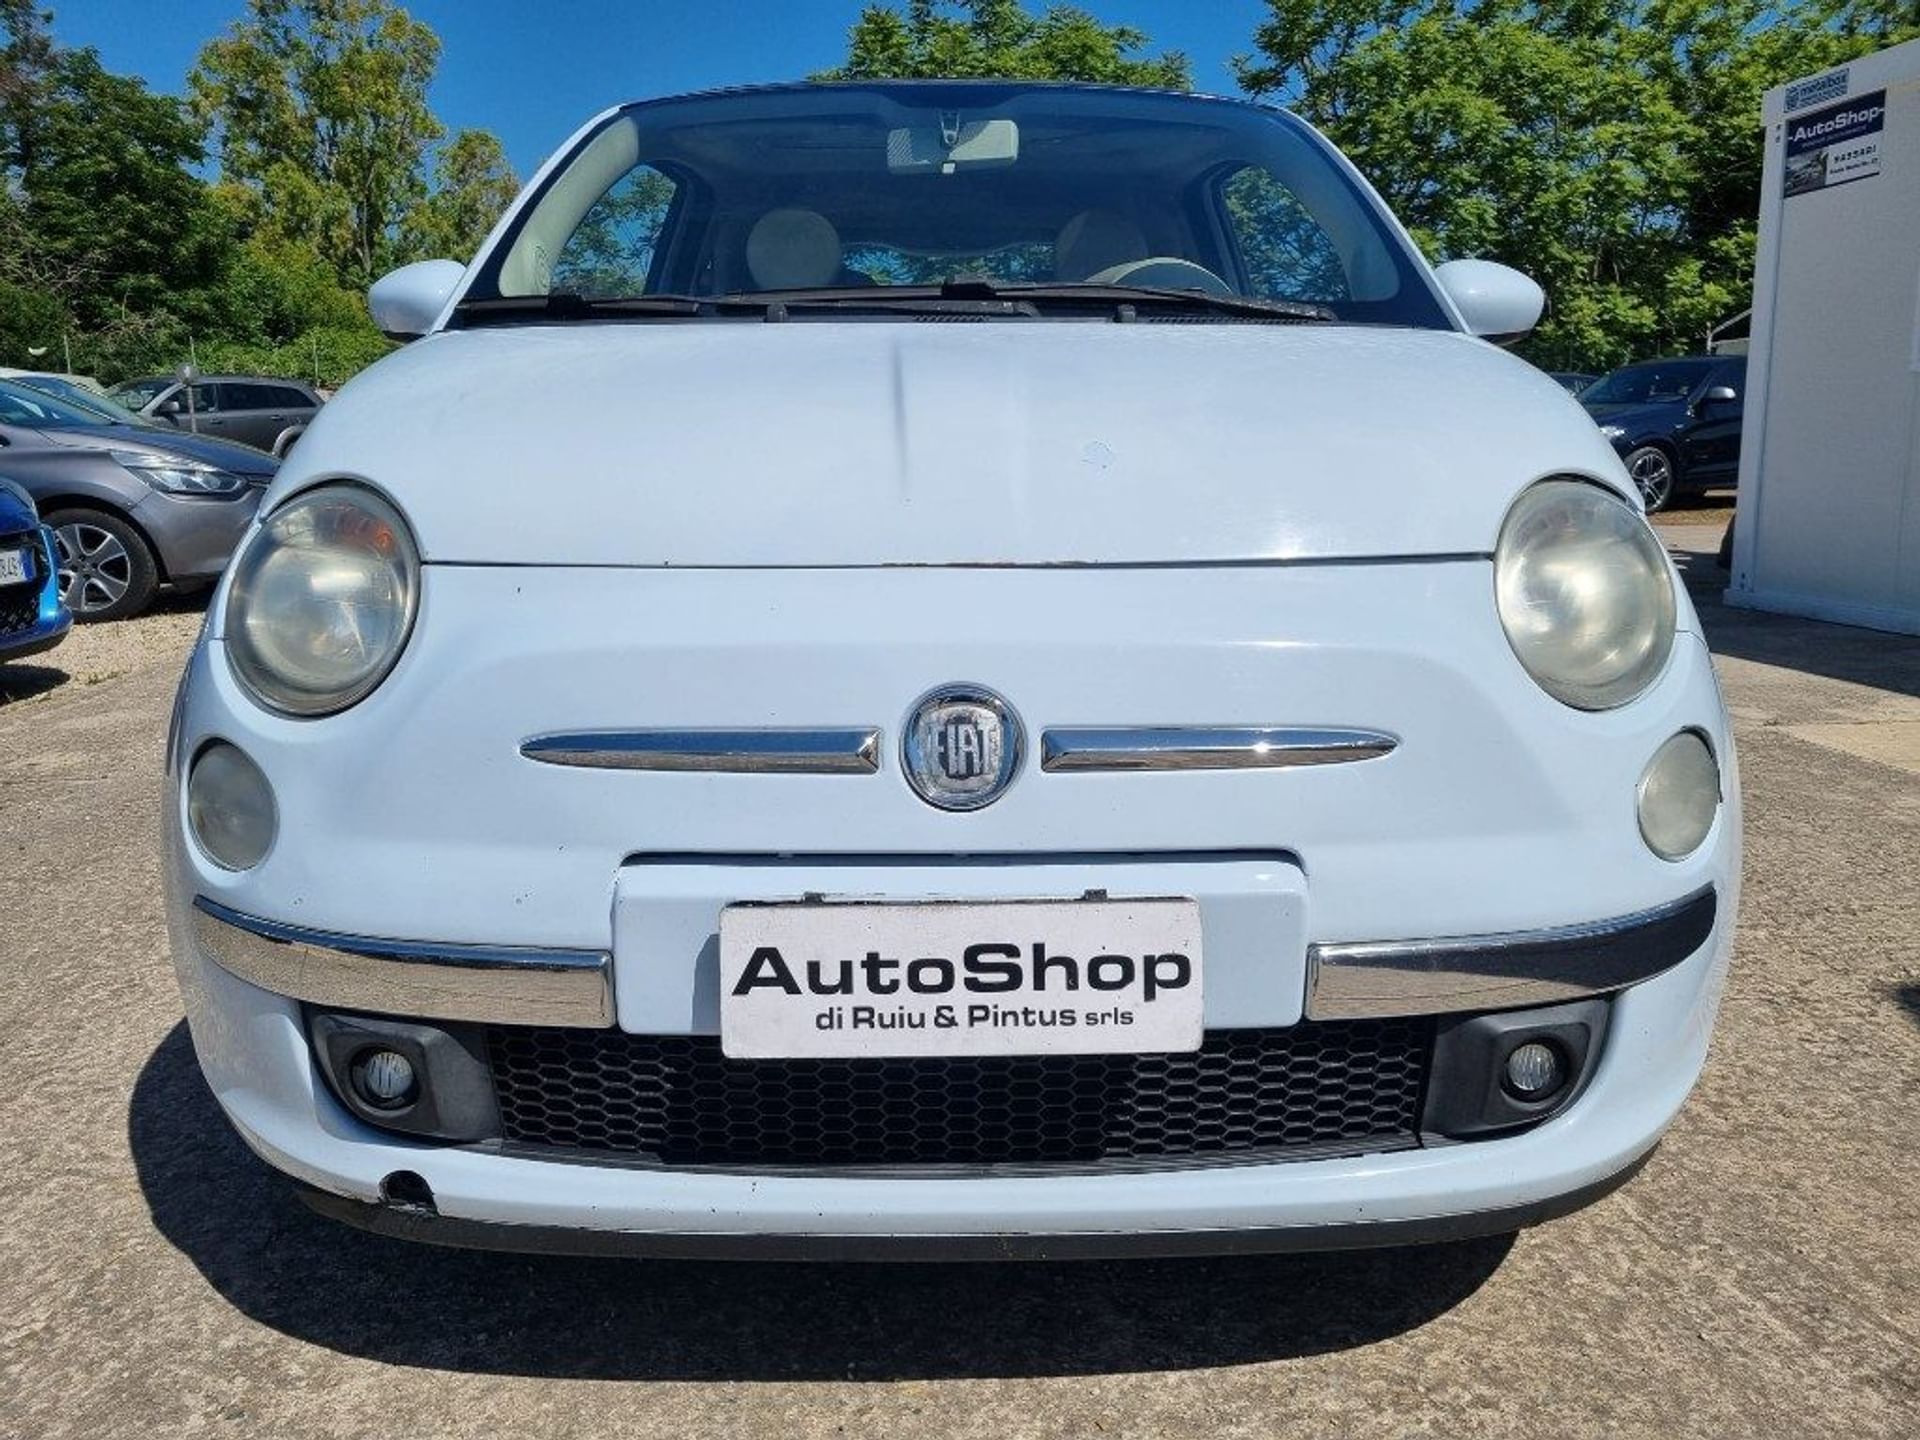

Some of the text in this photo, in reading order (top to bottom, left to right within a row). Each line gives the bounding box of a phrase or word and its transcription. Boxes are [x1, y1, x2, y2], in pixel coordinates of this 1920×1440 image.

[924, 719, 998, 778] FIAT
[731, 942, 1192, 1003] AutoShop
[815, 1004, 1134, 1031] di Ruiu & Pintus srls
